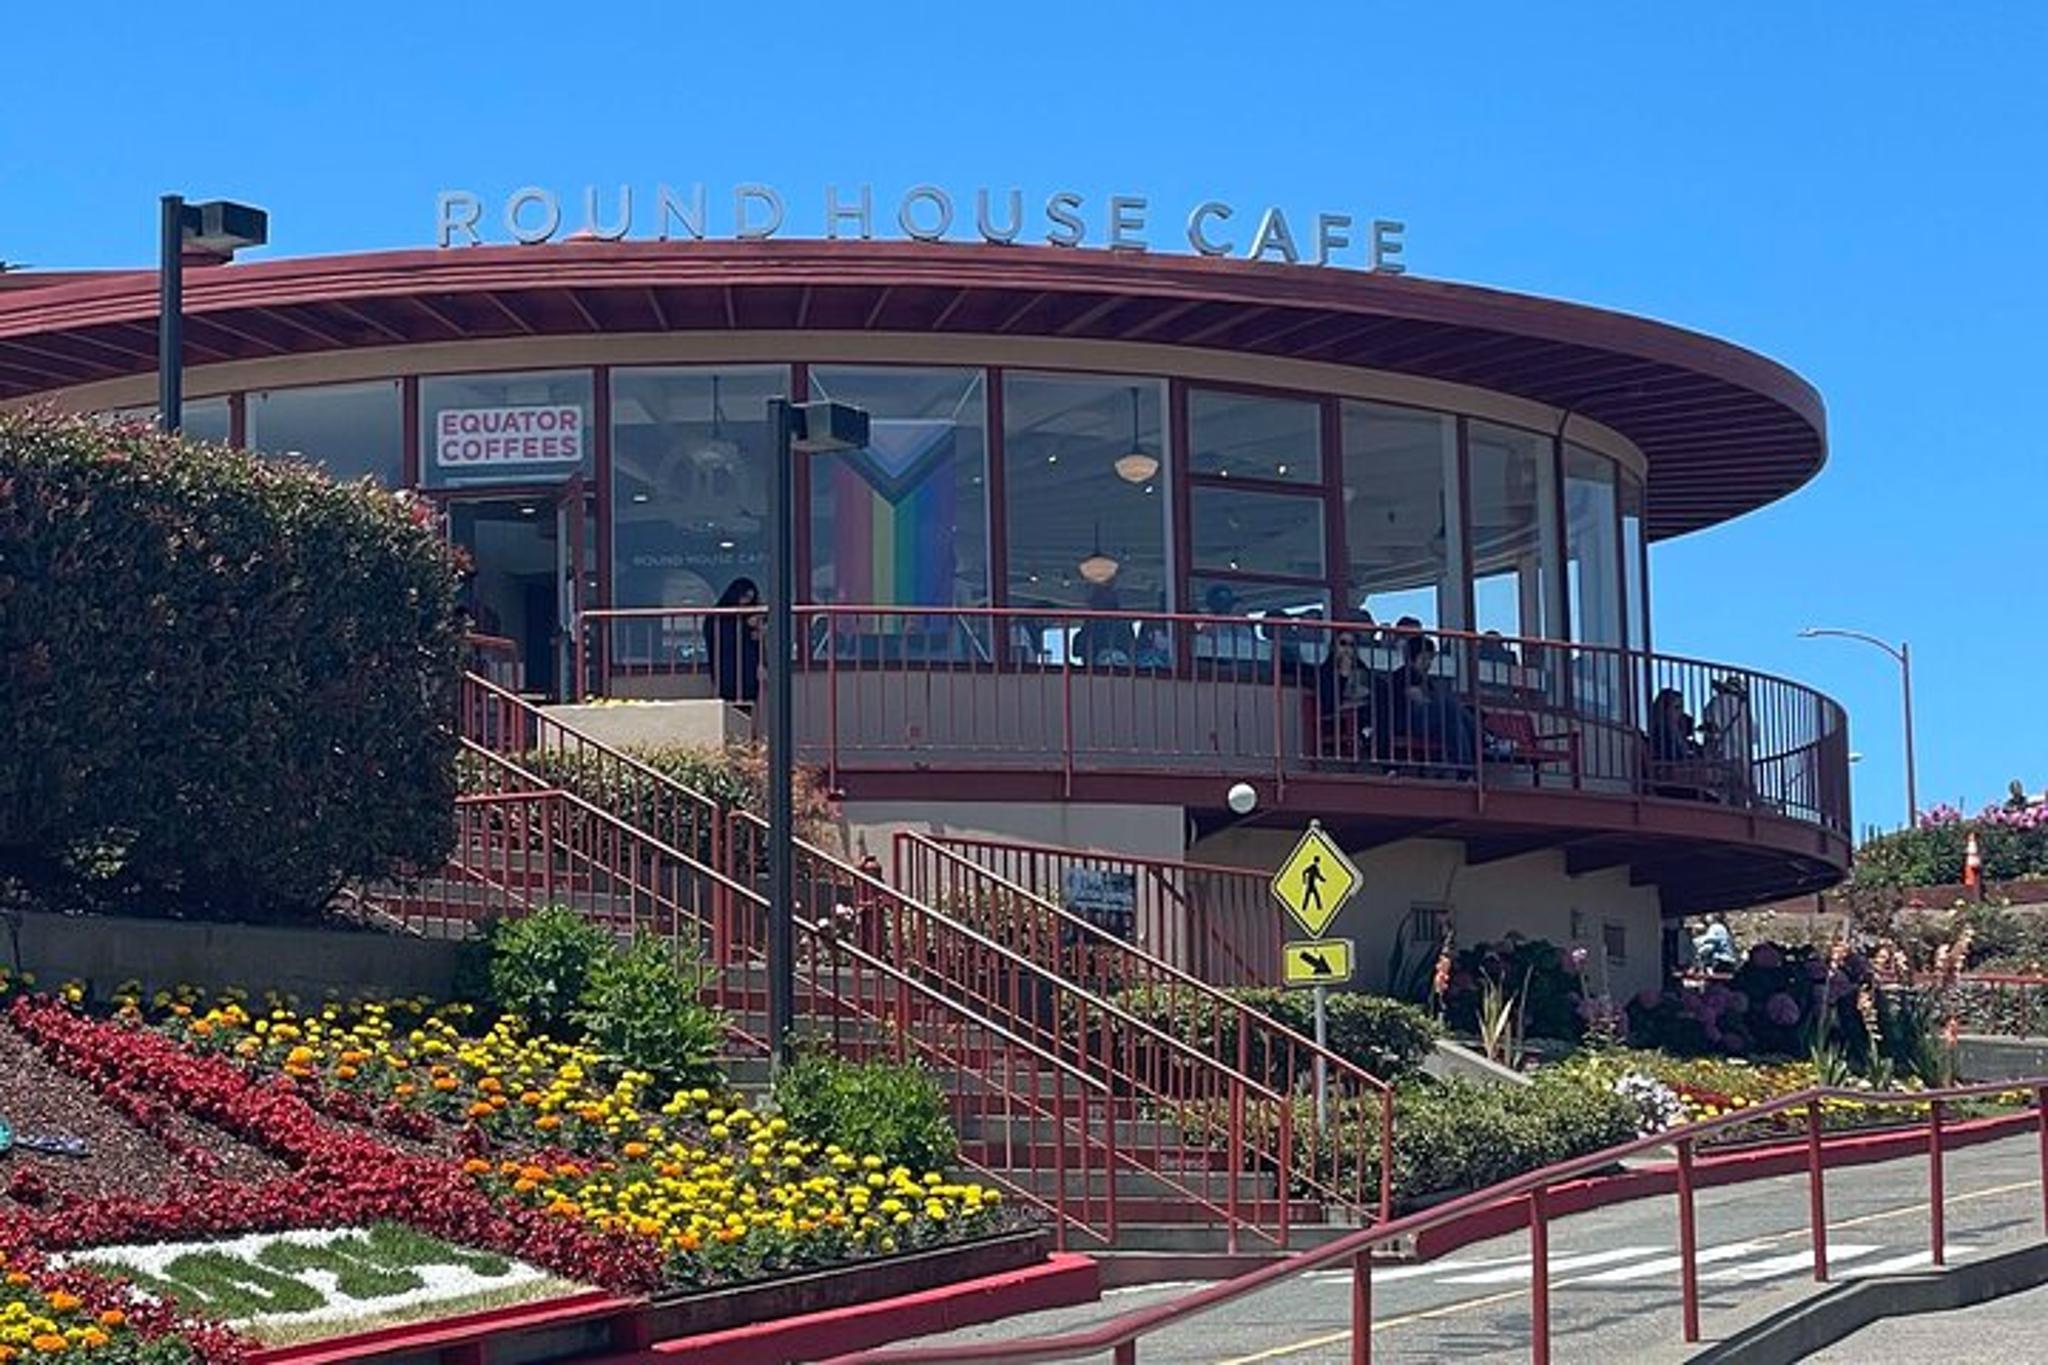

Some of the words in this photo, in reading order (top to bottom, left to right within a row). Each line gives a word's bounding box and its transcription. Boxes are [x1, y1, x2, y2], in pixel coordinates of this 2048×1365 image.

[438, 183, 784, 247] ROUND
[824, 185, 1148, 251] HOUSE
[1187, 201, 1406, 273] CAFE
[442, 410, 577, 435] EQUATOR
[442, 436, 577, 460] COFFEES
